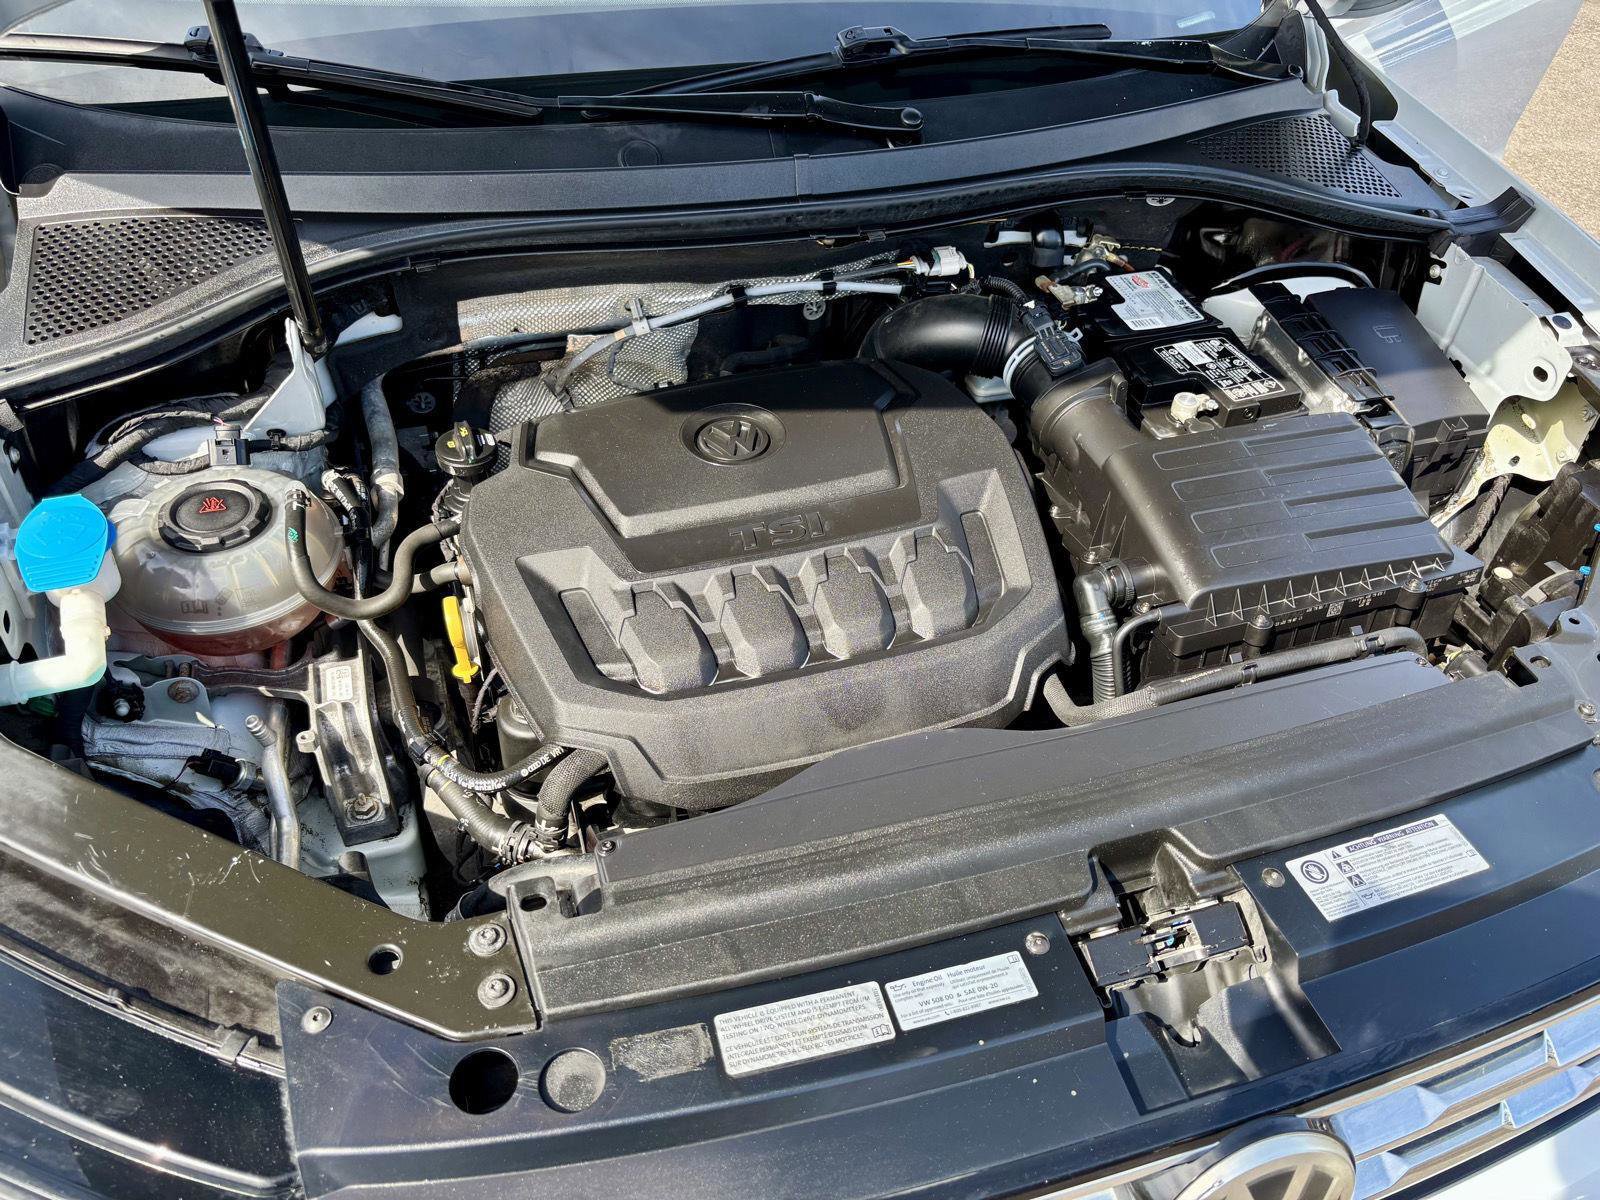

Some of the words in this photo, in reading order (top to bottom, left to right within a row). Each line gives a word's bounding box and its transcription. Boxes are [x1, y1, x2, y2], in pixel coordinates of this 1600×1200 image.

[728, 512, 825, 550] TSI
[540, 753, 551, 765] DE
[1348, 839, 1377, 852] ACHTUNG
[1377, 830, 1405, 842] WARNING
[1404, 820, 1436, 834] ATTENTION
[912, 977, 934, 988] Engine
[946, 969, 963, 978] Huile
[963, 964, 986, 974] moteur
